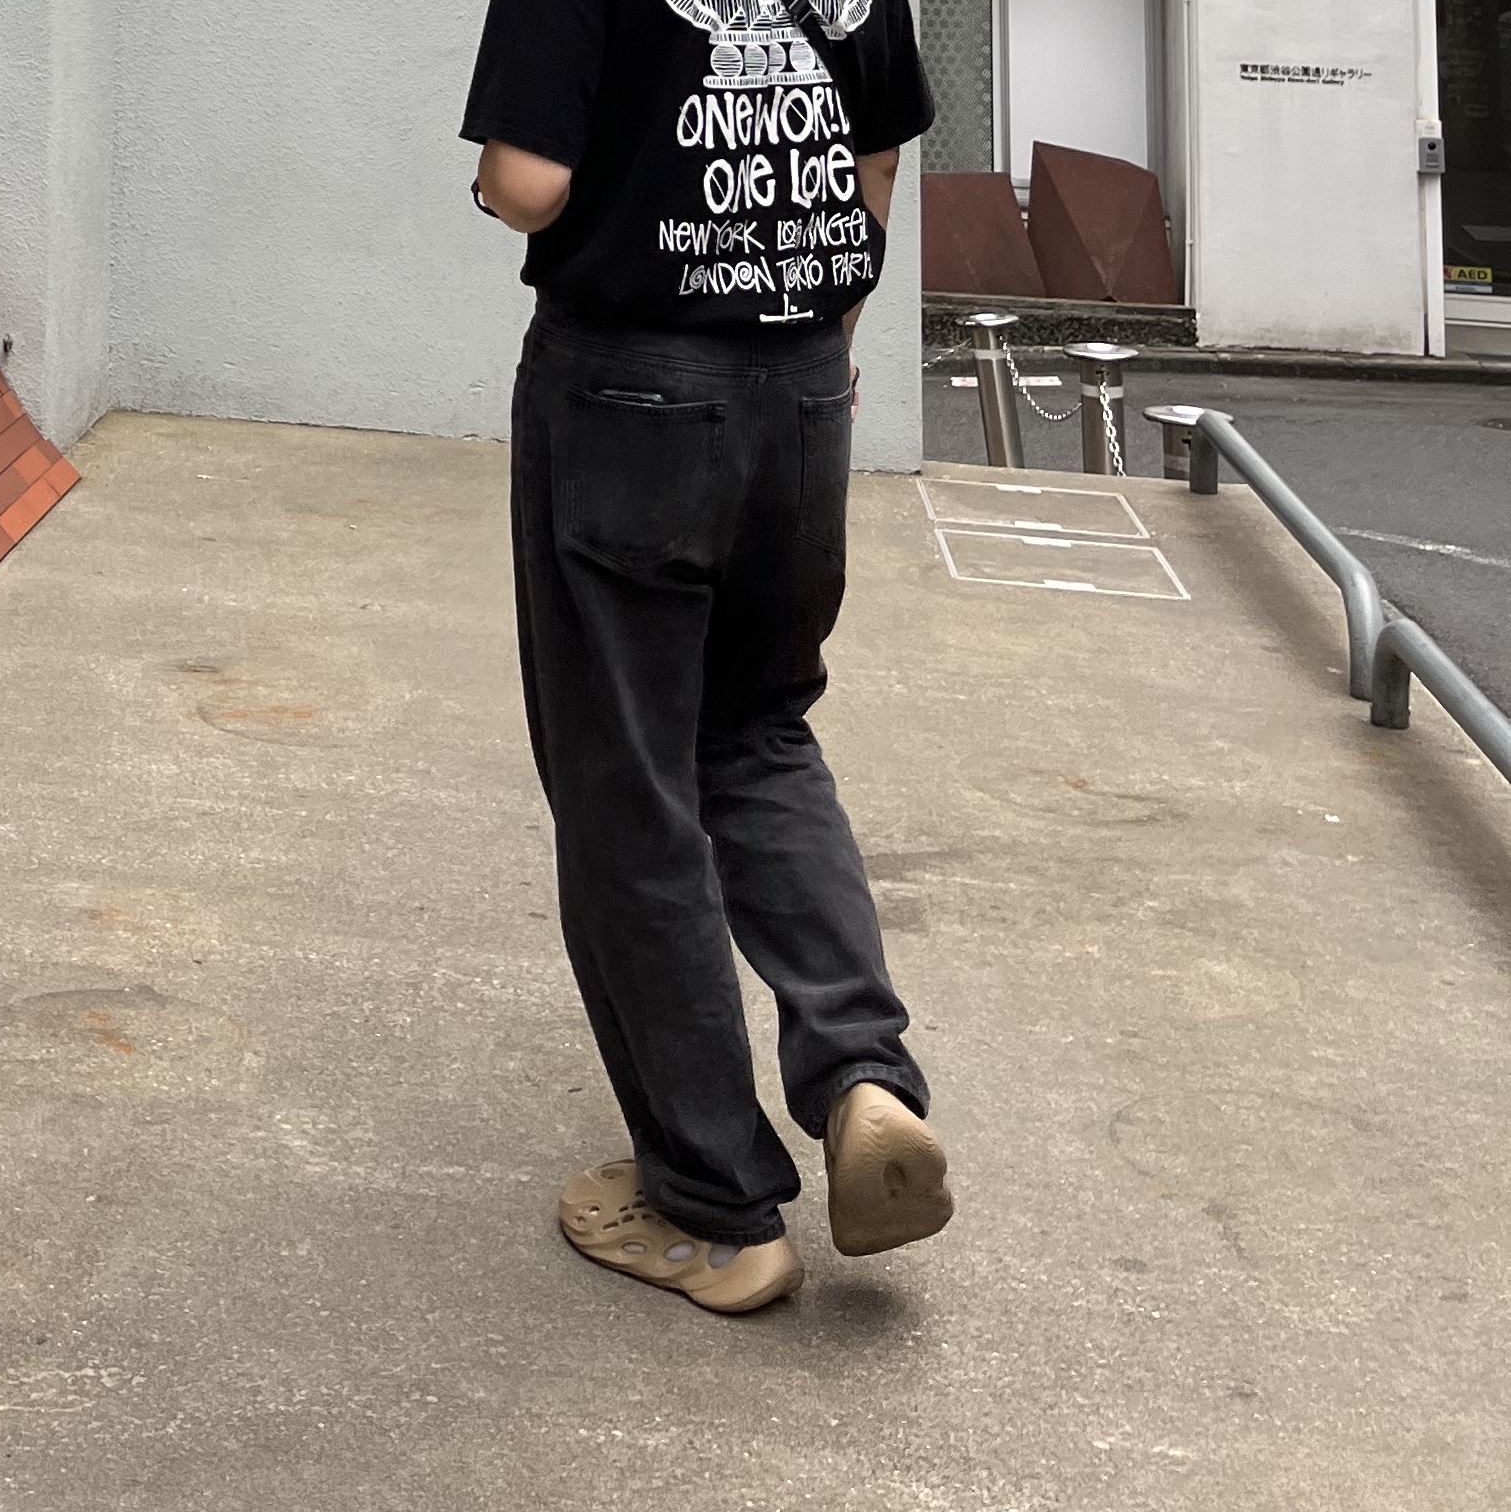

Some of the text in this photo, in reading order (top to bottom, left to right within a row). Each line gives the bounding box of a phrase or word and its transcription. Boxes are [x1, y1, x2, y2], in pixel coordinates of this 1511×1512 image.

[678, 256, 777, 296] LONDON
[776, 253, 824, 291] TOKYO
[1457, 269, 1488, 280] AED
